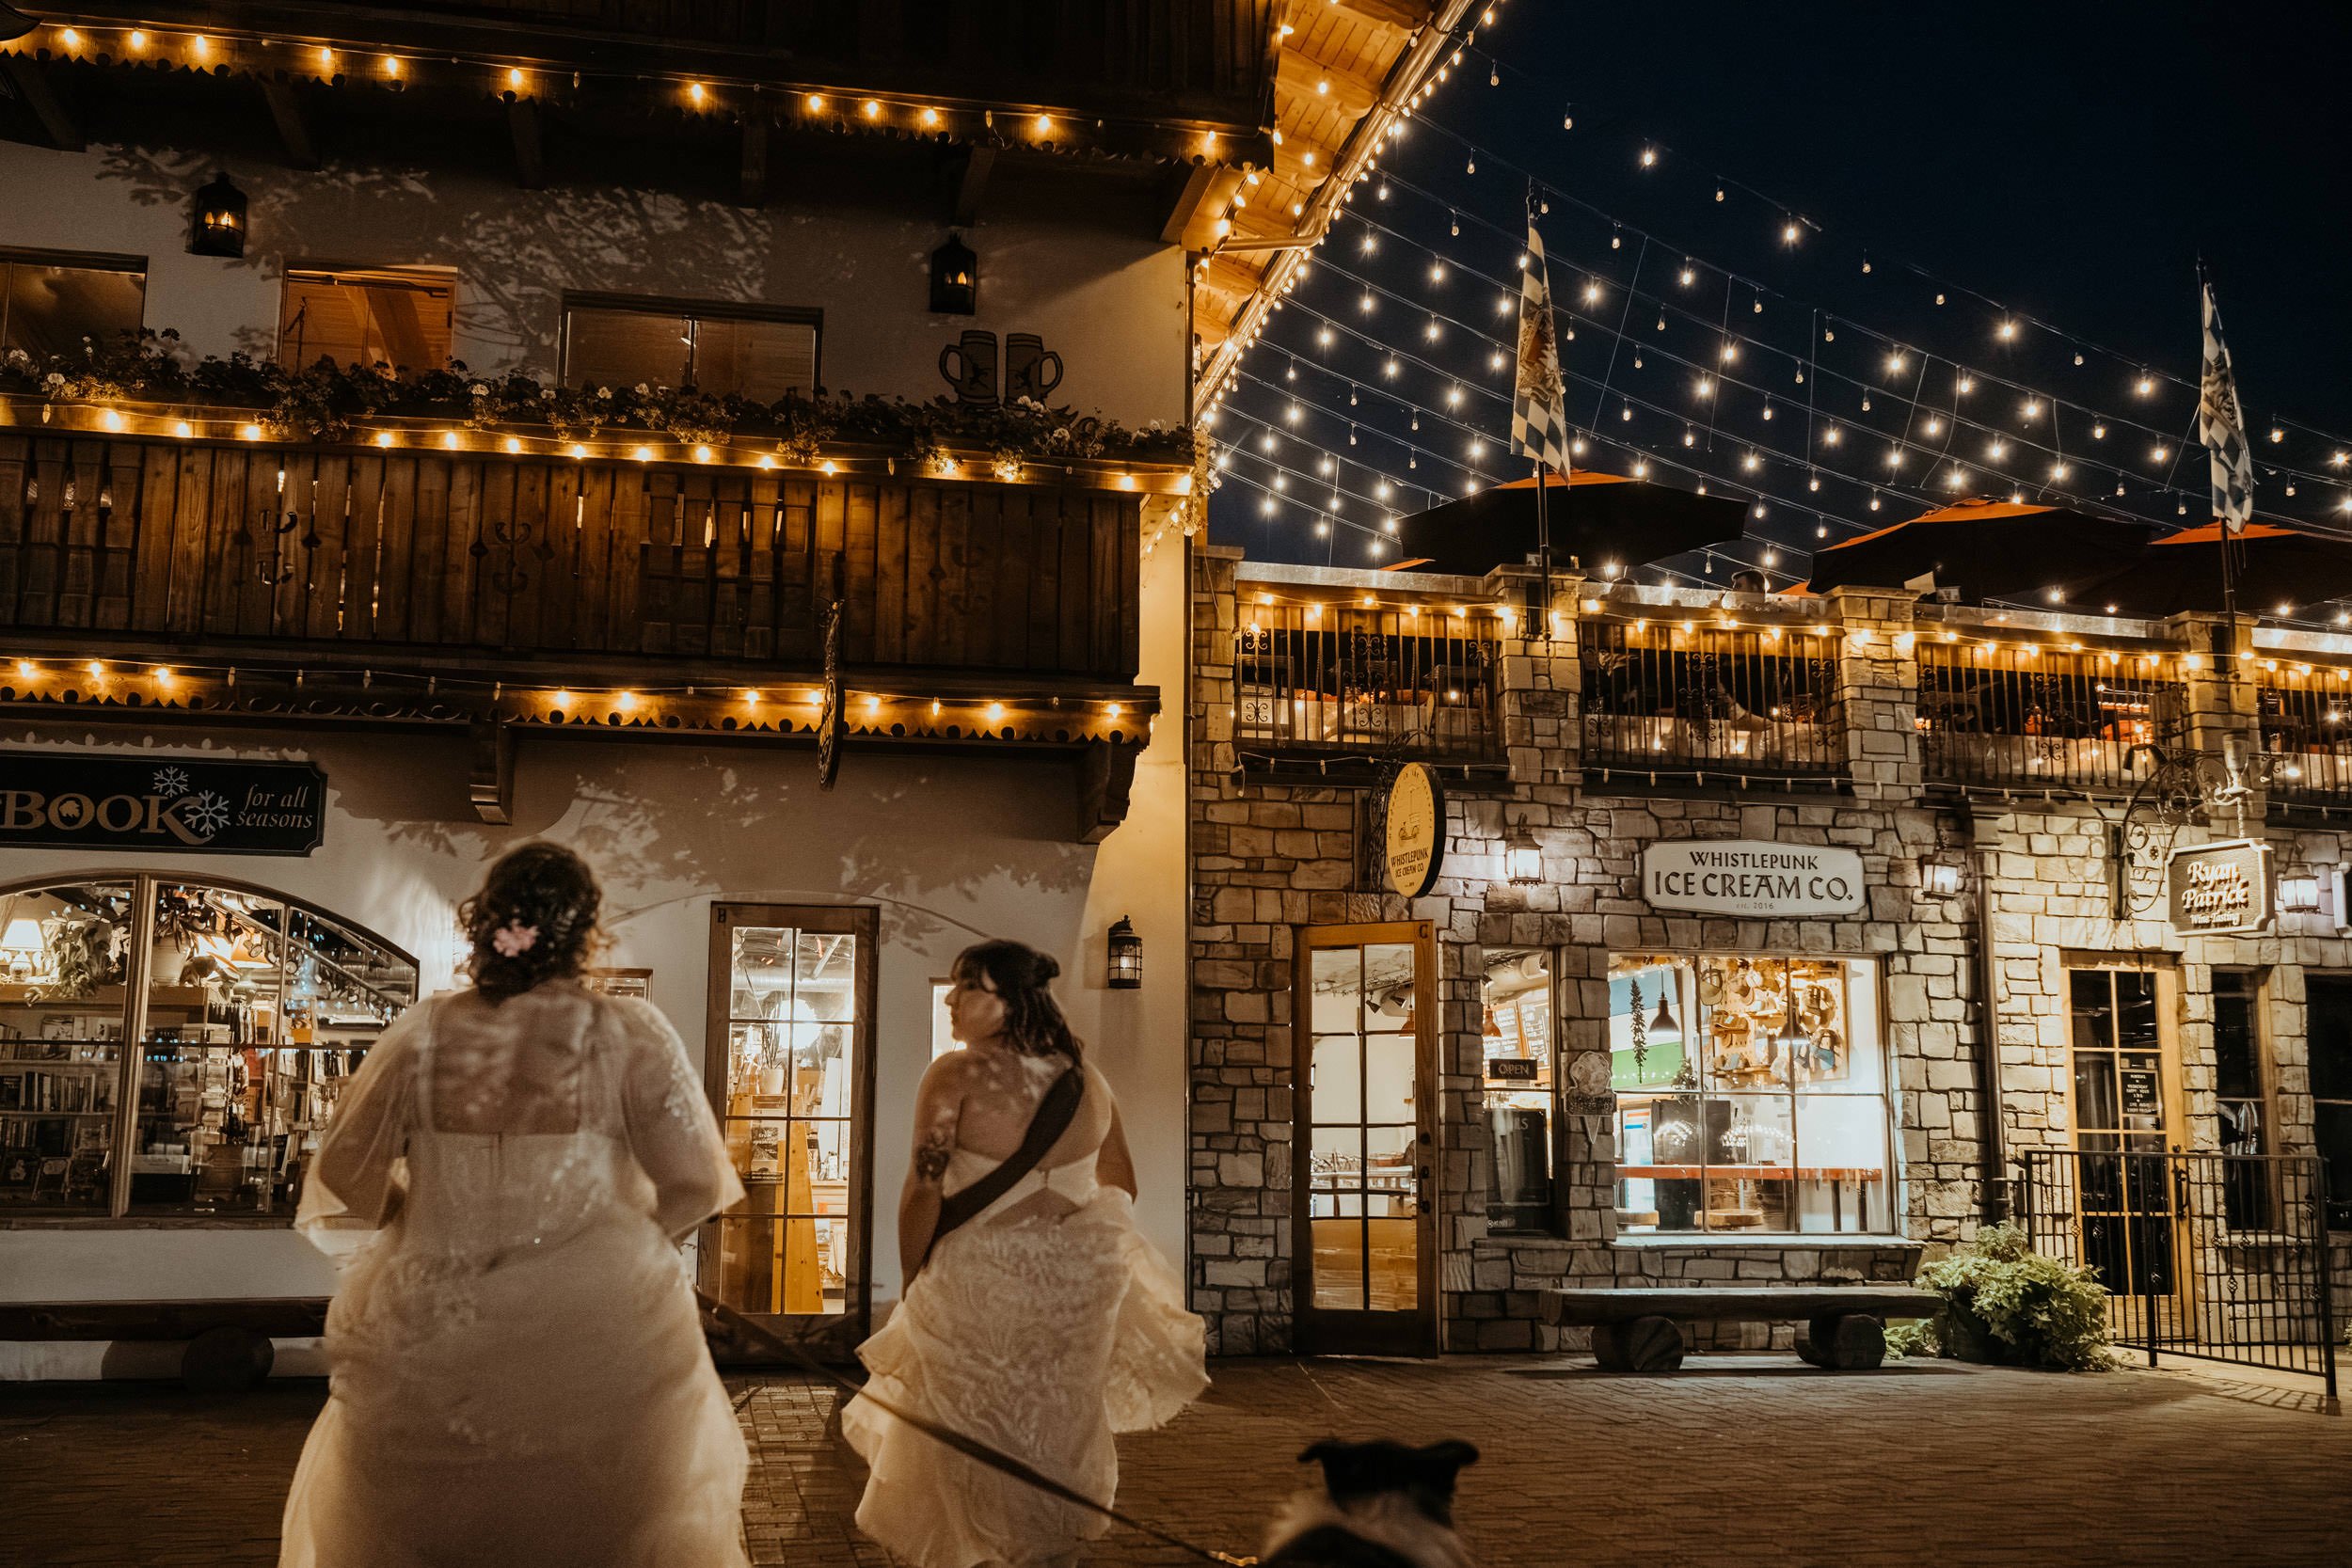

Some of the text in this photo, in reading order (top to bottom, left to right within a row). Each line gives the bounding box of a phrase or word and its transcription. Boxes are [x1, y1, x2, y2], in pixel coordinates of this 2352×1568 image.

[245, 784, 309, 809] for all
[0, 790, 215, 845] BOOK
[236, 811, 313, 829] seasons
[1391, 847, 1429, 867] WHISTLEPUNK
[1690, 851, 1819, 870] WHISTLEPUNK
[1402, 864, 1416, 876] CREAM
[2186, 861, 2240, 889] Ryan
[1655, 871, 1853, 900] ICE CREAM CO.
[2182, 879, 2249, 909] Patrick
[1753, 901, 1774, 910] 2016
[2211, 911, 2240, 926] Tasting
[1420, 925, 1428, 939] C
[1498, 1064, 1529, 1075] OPEN
